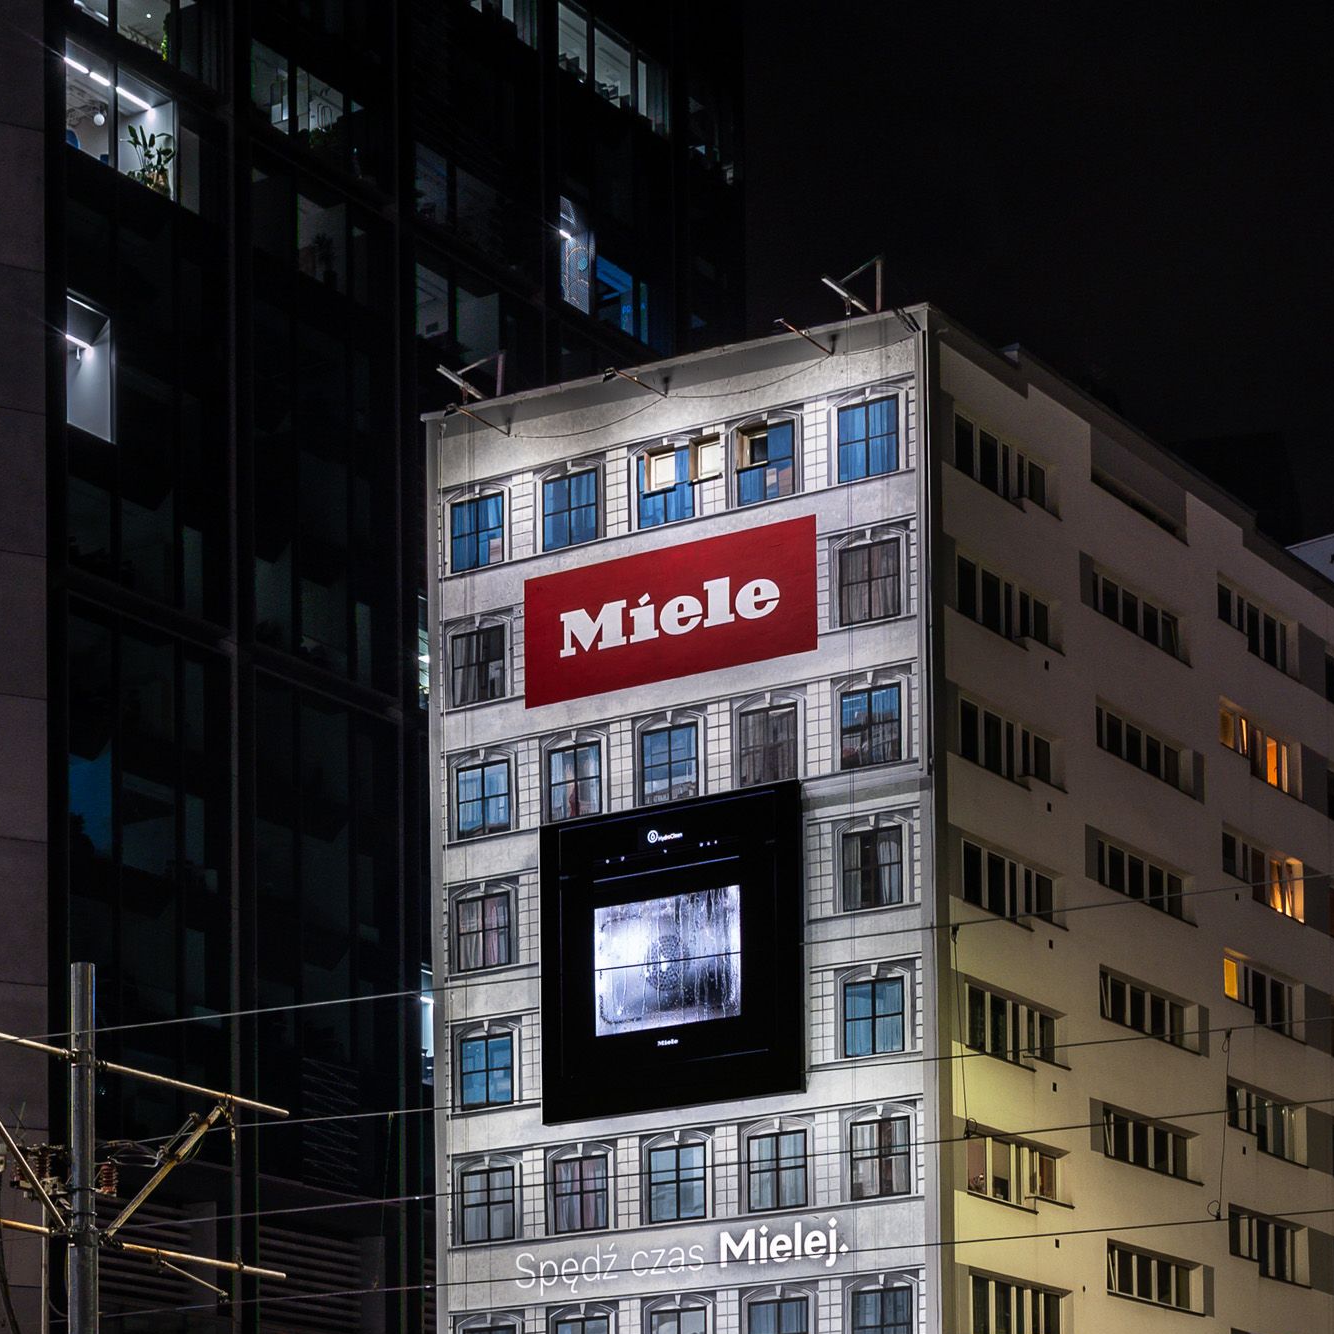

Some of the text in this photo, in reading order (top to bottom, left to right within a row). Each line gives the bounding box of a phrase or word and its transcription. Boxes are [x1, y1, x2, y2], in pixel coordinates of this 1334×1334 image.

[559, 576, 781, 659] Miele
[657, 1038, 679, 1047] Miele
[514, 1216, 849, 1296] Spędź czas Mielej.
